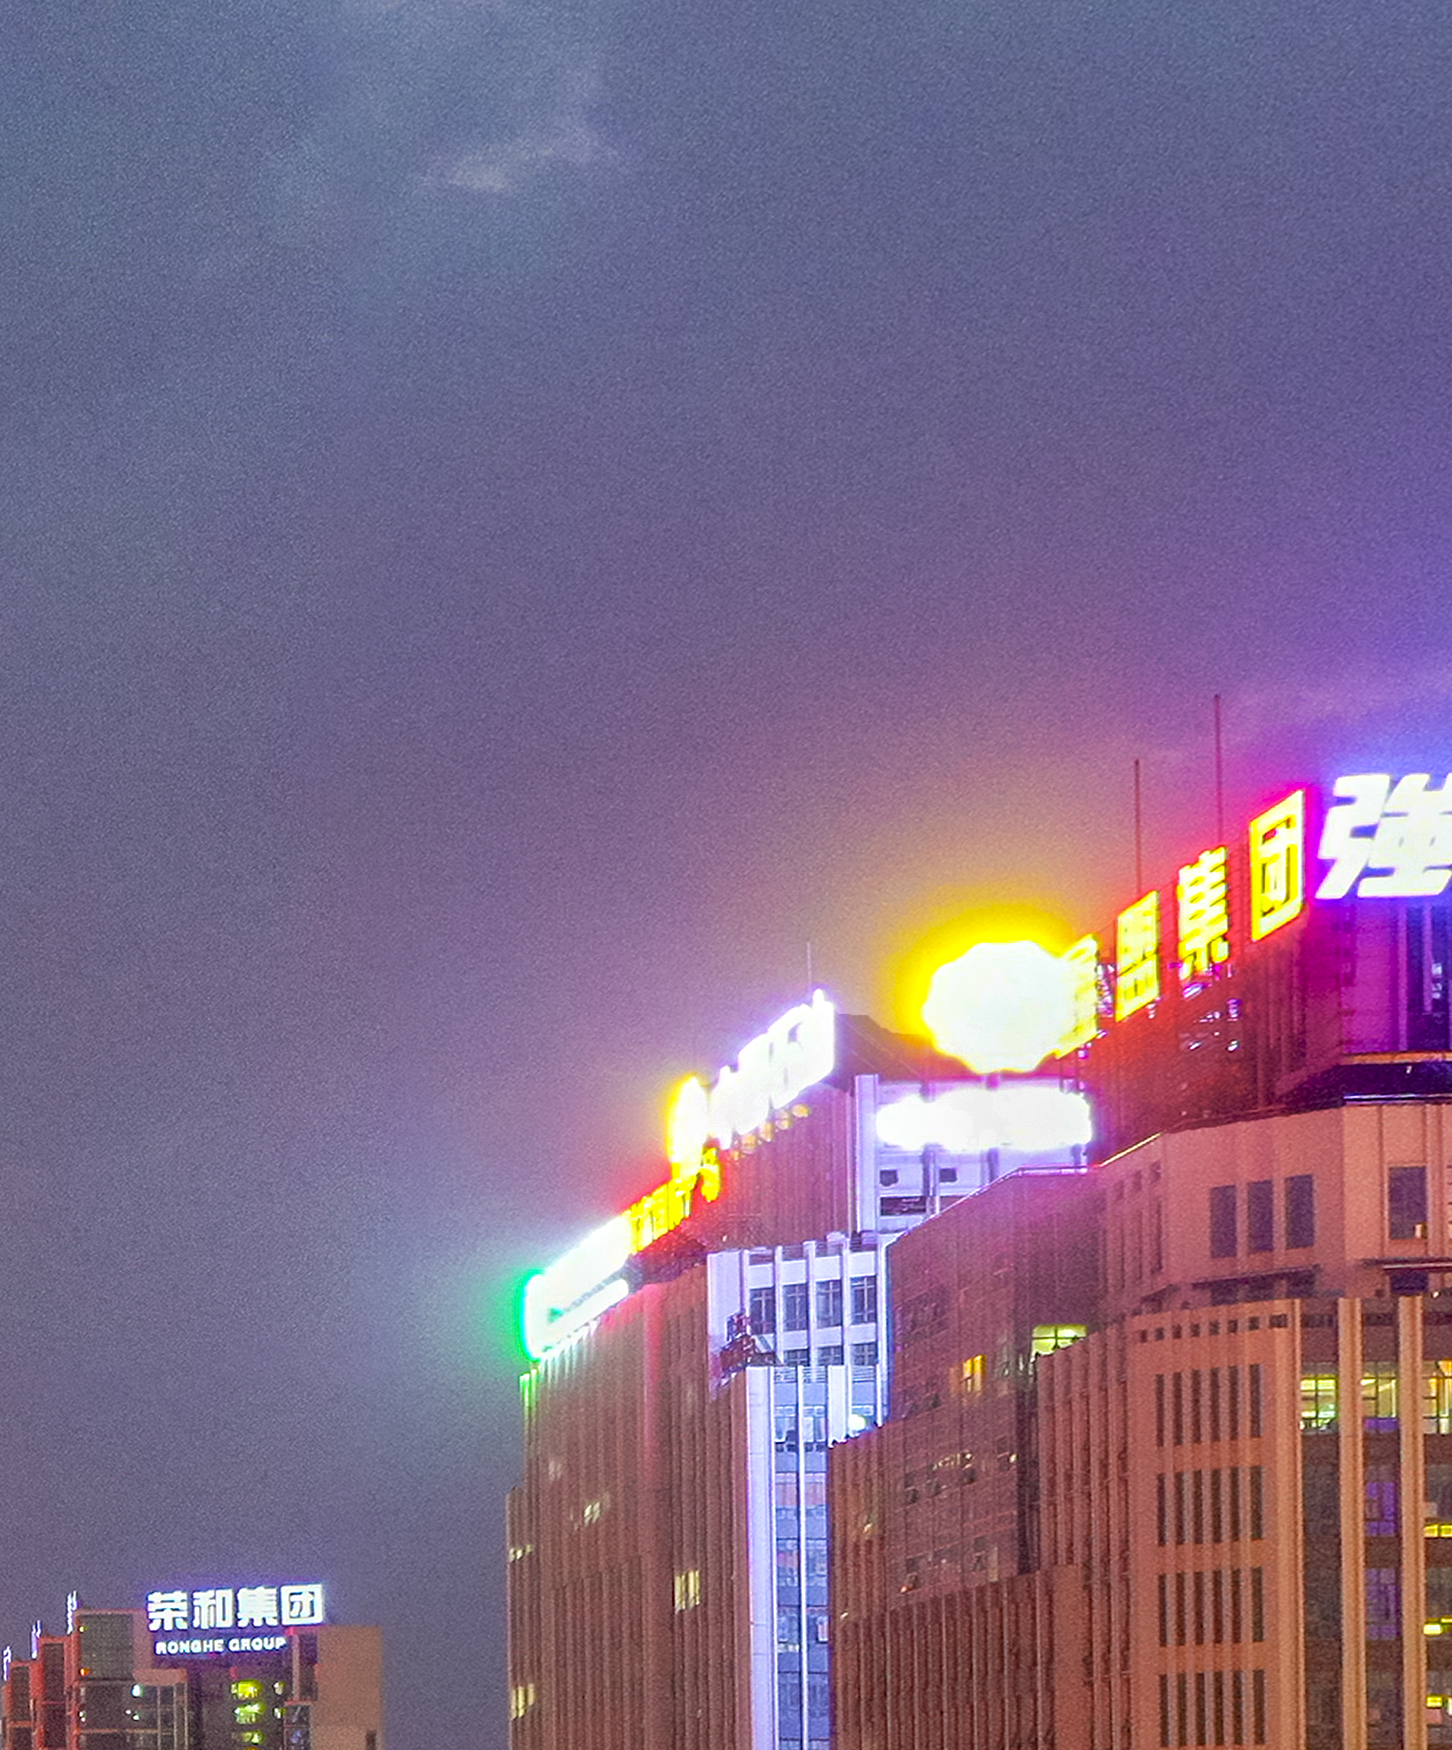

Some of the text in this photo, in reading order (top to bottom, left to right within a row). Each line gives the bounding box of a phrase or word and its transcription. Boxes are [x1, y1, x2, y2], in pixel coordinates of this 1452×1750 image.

[146, 1583, 324, 1631] 荣和集团
[155, 1636, 287, 1655] RONGHE GROUP
